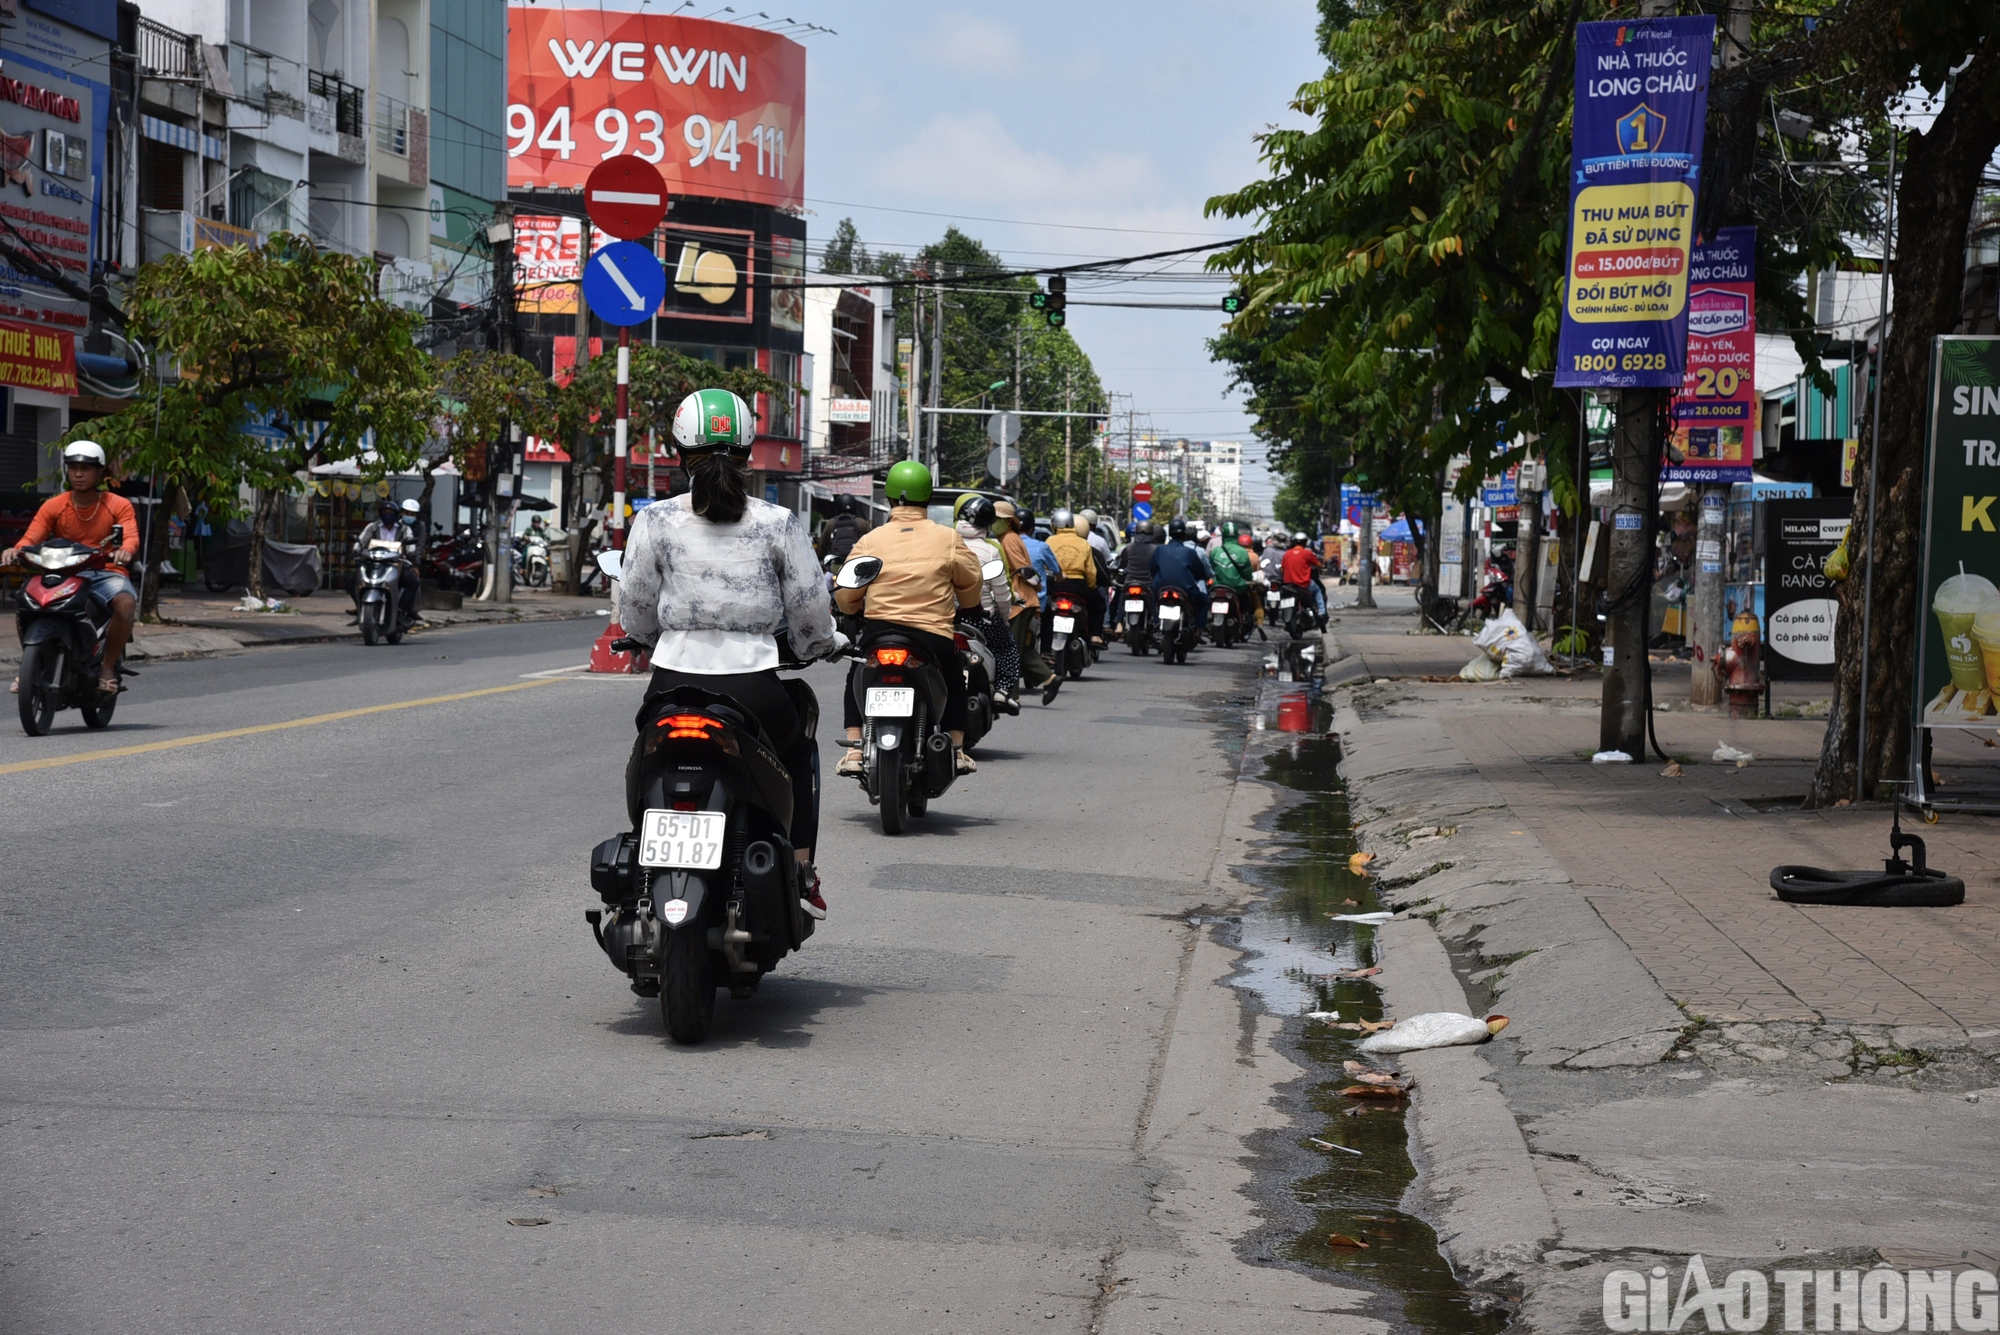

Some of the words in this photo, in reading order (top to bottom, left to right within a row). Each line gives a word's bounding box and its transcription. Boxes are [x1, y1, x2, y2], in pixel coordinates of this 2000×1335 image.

[1636, 31, 1649, 39] FPT
[1650, 29, 1672, 39] Retail
[548, 38, 646, 81] WE
[654, 44, 747, 92] WIN
[1598, 50, 1630, 70] NHÀ
[1634, 45, 1688, 68] THUỐC
[1589, 77, 1642, 97] LONG
[1645, 69, 1697, 93] CHÂU
[1630, 113, 1648, 150] 1
[507, 104, 576, 158] 94
[594, 107, 665, 165] 93
[683, 114, 741, 172] 94
[752, 123, 784, 180] 111
[1585, 160, 1606, 174] BÚT
[1607, 158, 1630, 170] TIÊM
[1632, 154, 1650, 167] TIỂU
[1651, 157, 1689, 169] ĐƯỜNG
[1581, 208, 1614, 222] THU
[1618, 206, 1650, 220] MUA
[1654, 200, 1689, 218] BÚT
[1585, 227, 1608, 245] ĐÃ
[1612, 225, 1634, 243] SỬ
[1636, 227, 1681, 245] DỤNG
[1692, 249, 1705, 262] HÀ
[1707, 245, 1739, 261] THUỐC
[517, 265, 580, 279] DELIVER
[1578, 262, 1595, 272] ĐẾN
[1712, 262, 1747, 278] CHÂU
[1576, 282, 1605, 300] ĐỔI
[1609, 283, 1638, 299] BÚT
[1641, 281, 1672, 298] MỚI
[1576, 303, 1602, 314] CHÍNH
[1647, 303, 1669, 313] LOẠI
[1703, 313, 1722, 324] GẤP
[1724, 313, 1743, 324] ĐÔI
[34, 333, 61, 362] NHÀ
[1591, 338, 1614, 352] GỌI
[1617, 337, 1650, 350] NGAY
[1573, 354, 1617, 371] 1800
[1622, 353, 1666, 371] 6928
[1690, 351, 1716, 364] THẢO
[1718, 352, 1750, 364] DƯỢC
[1952, 385, 2000, 416] SIN
[1669, 470, 1692, 480] 1800
[1693, 469, 1718, 480] 6928
[1757, 490, 1787, 499] SINH
[1790, 486, 1807, 499] TỐ
[1792, 553, 1815, 570] CÀ
[1781, 575, 1825, 588] RANG
[1775, 614, 1789, 623] Cà
[1792, 614, 1809, 625] phê
[1812, 613, 1825, 623] đá
[1775, 633, 1789, 642] Cà
[1792, 633, 1809, 643] phê
[1812, 632, 1829, 642] sữa
[656, 815, 712, 839] 65-D1
[645, 839, 718, 865] 591.87
